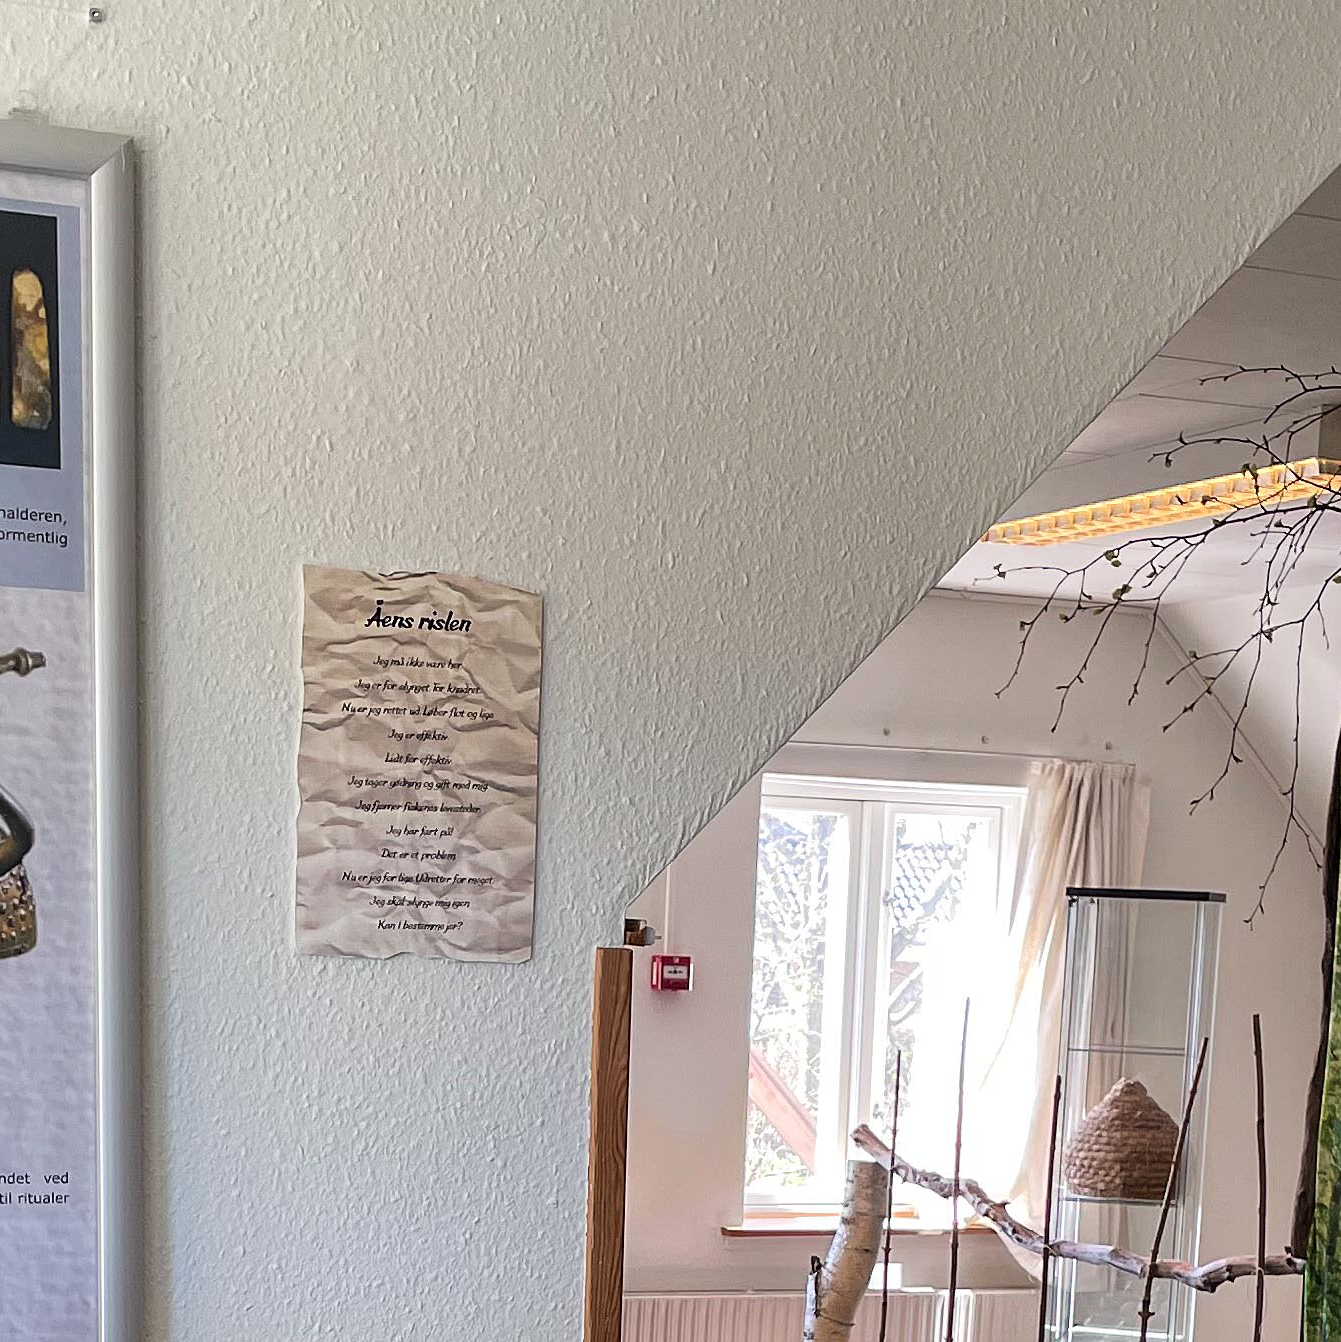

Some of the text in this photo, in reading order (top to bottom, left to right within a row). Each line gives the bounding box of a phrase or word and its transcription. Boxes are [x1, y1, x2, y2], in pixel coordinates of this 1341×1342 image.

[365, 600, 471, 632] Åens rislen
[406, 657, 424, 668] ikke
[386, 825, 402, 836] Jeg
[404, 826, 418, 836] har
[420, 826, 437, 837] fart
[378, 920, 395, 930] Kan
[402, 920, 444, 930] bestemme
[444, 922, 463, 933] jer?
[43, 1171, 68, 1184] ved
[17, 1191, 70, 1205] ritualer
